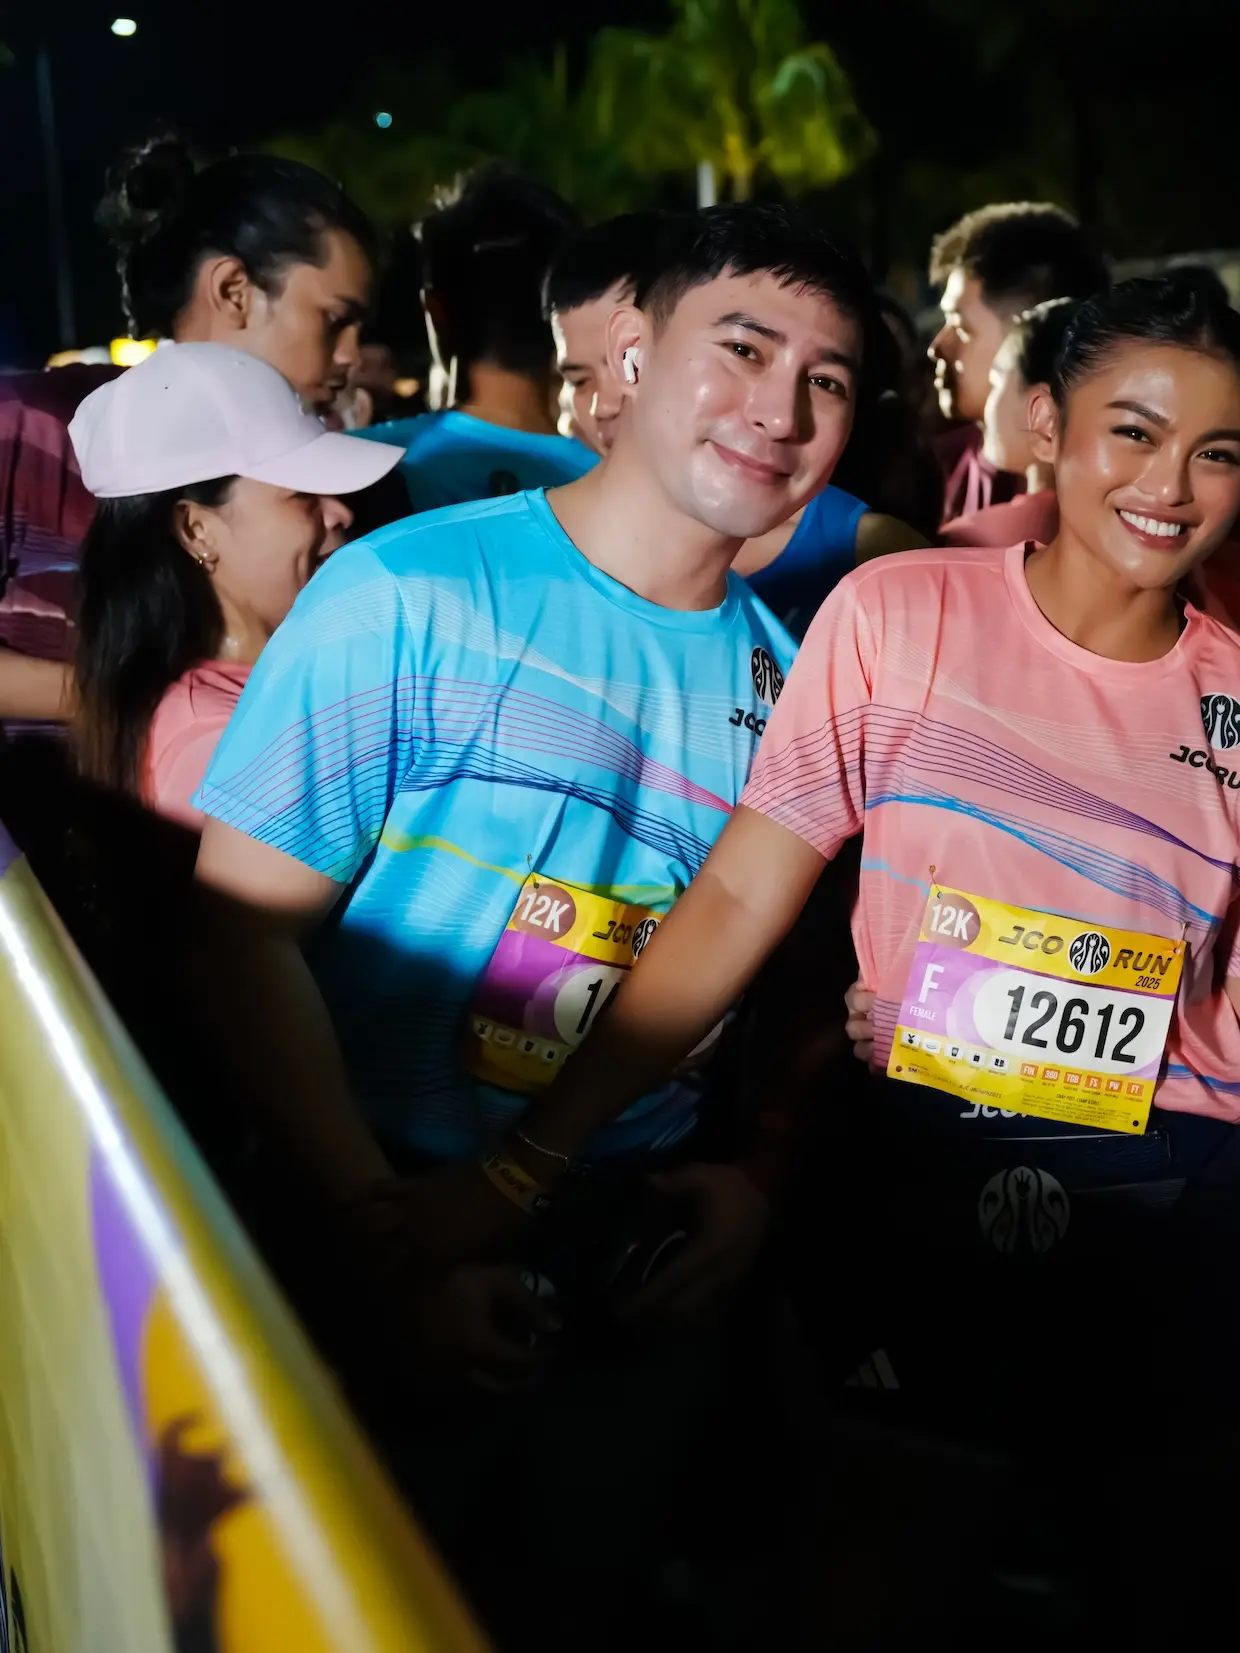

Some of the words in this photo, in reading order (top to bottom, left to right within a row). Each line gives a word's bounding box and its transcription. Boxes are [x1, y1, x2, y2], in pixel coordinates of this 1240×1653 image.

[520, 892, 571, 933] 12K
[593, 920, 633, 944] JCO
[930, 904, 974, 942] 12K
[998, 925, 1064, 955] JCO
[1113, 949, 1173, 975] RUN
[918, 963, 944, 1004] F
[1135, 976, 1161, 990] 2025
[909, 1005, 936, 1021] FEMALE
[1003, 985, 1146, 1064] 12612
